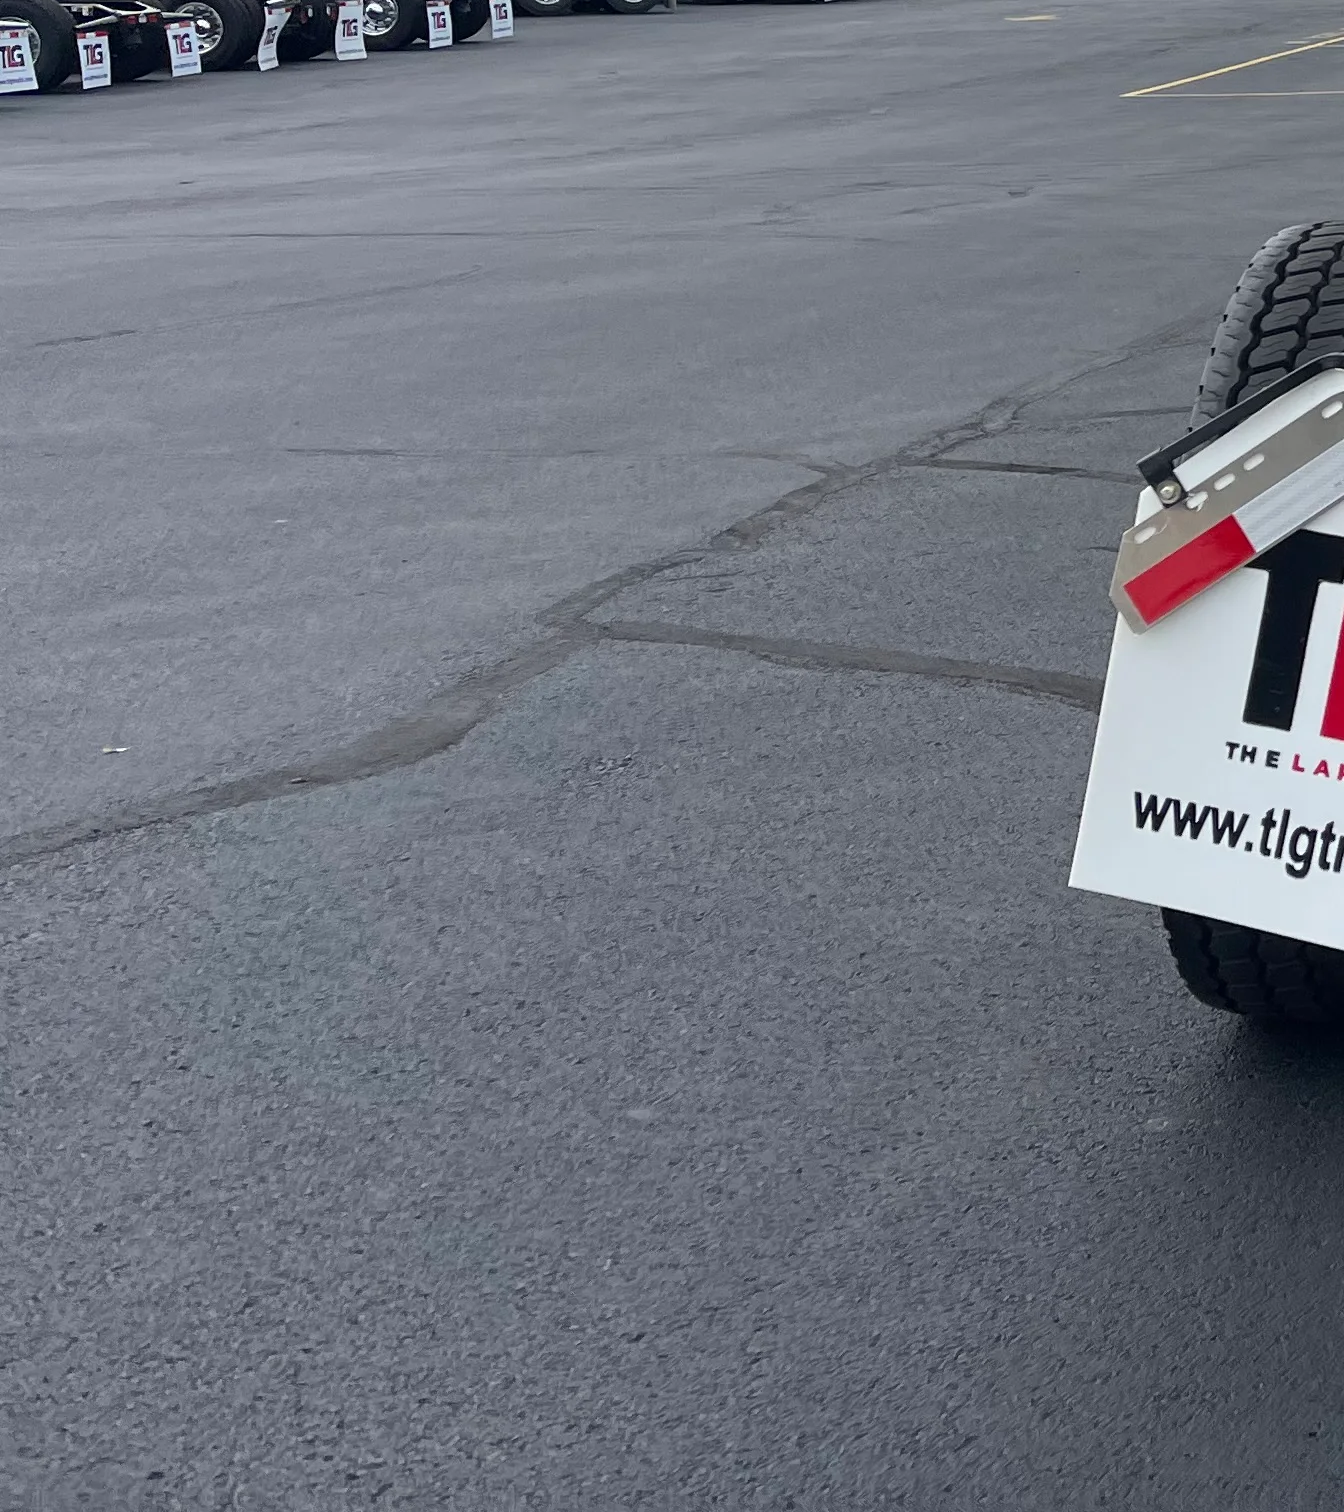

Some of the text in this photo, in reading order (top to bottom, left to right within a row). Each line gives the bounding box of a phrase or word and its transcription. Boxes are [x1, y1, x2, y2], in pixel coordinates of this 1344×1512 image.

[83, 43, 104, 66] TLG
[172, 33, 192, 55] TLG
[1225, 740, 1281, 769] THE
